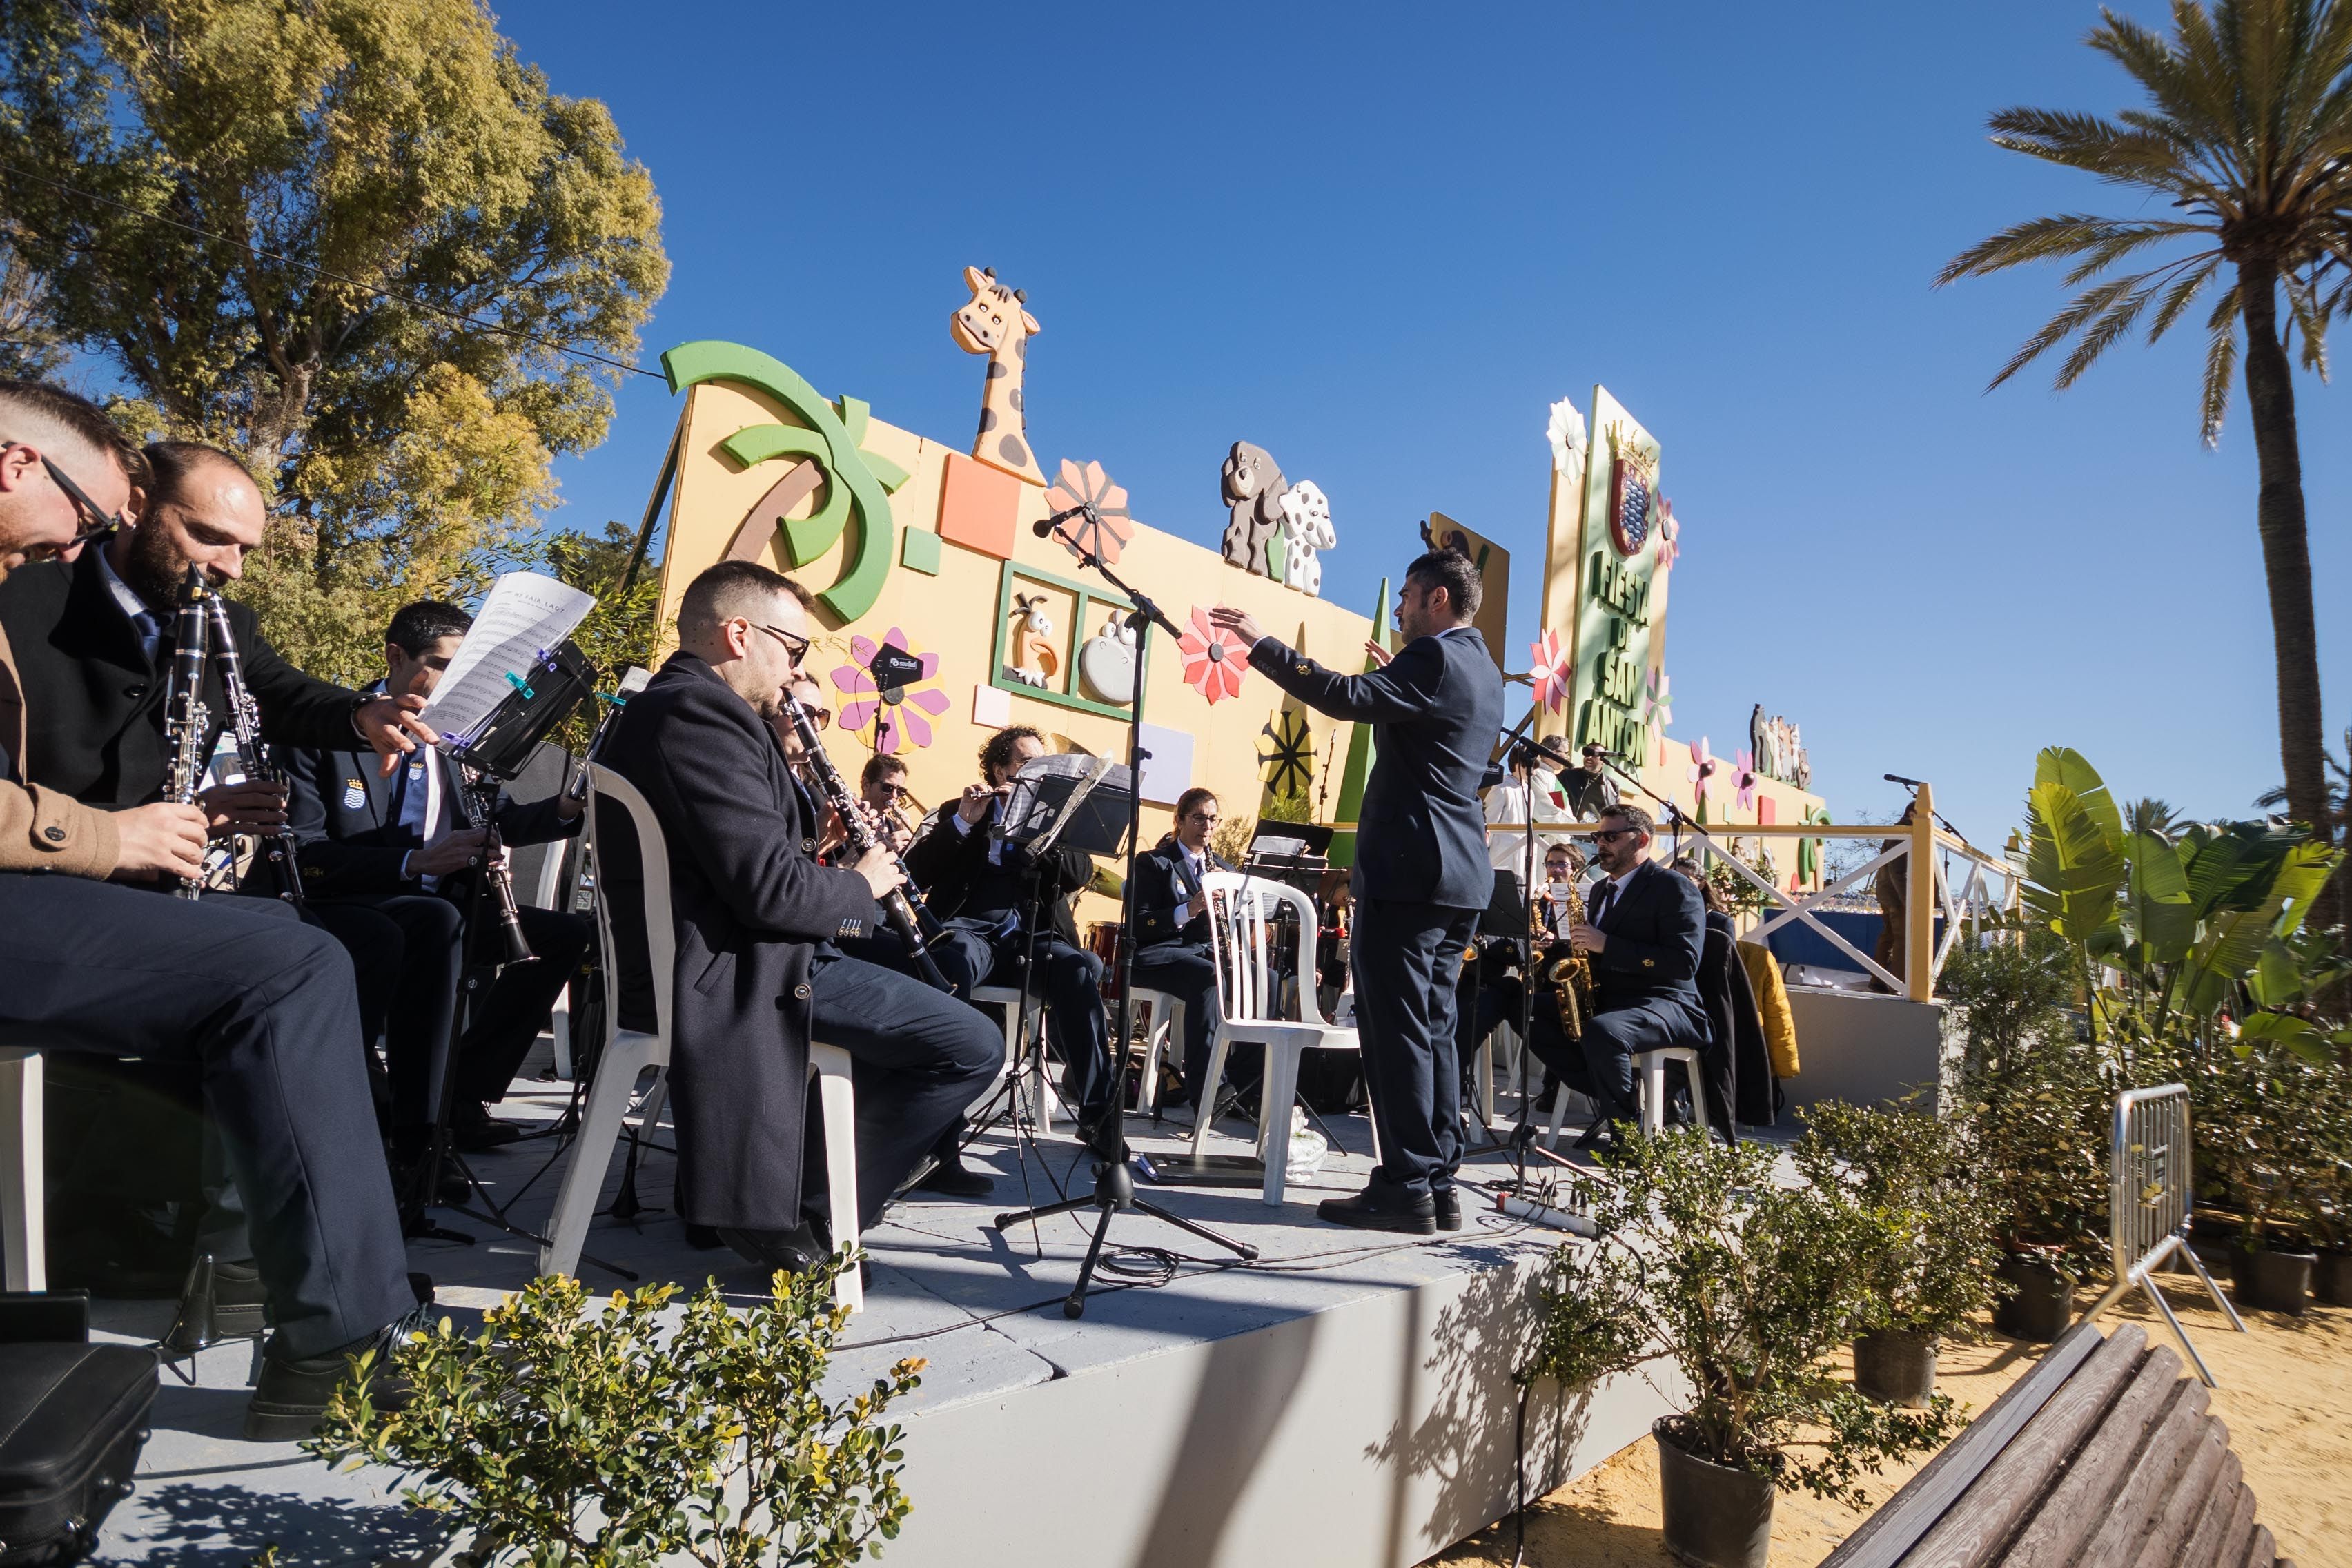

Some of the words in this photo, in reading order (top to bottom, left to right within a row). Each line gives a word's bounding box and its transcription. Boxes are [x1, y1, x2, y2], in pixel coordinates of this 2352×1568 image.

[1594, 551, 1649, 626] FIESTA
[1613, 618, 1631, 651] DE
[1599, 651, 1639, 709] SAN
[1581, 698, 1649, 767] ANTON
